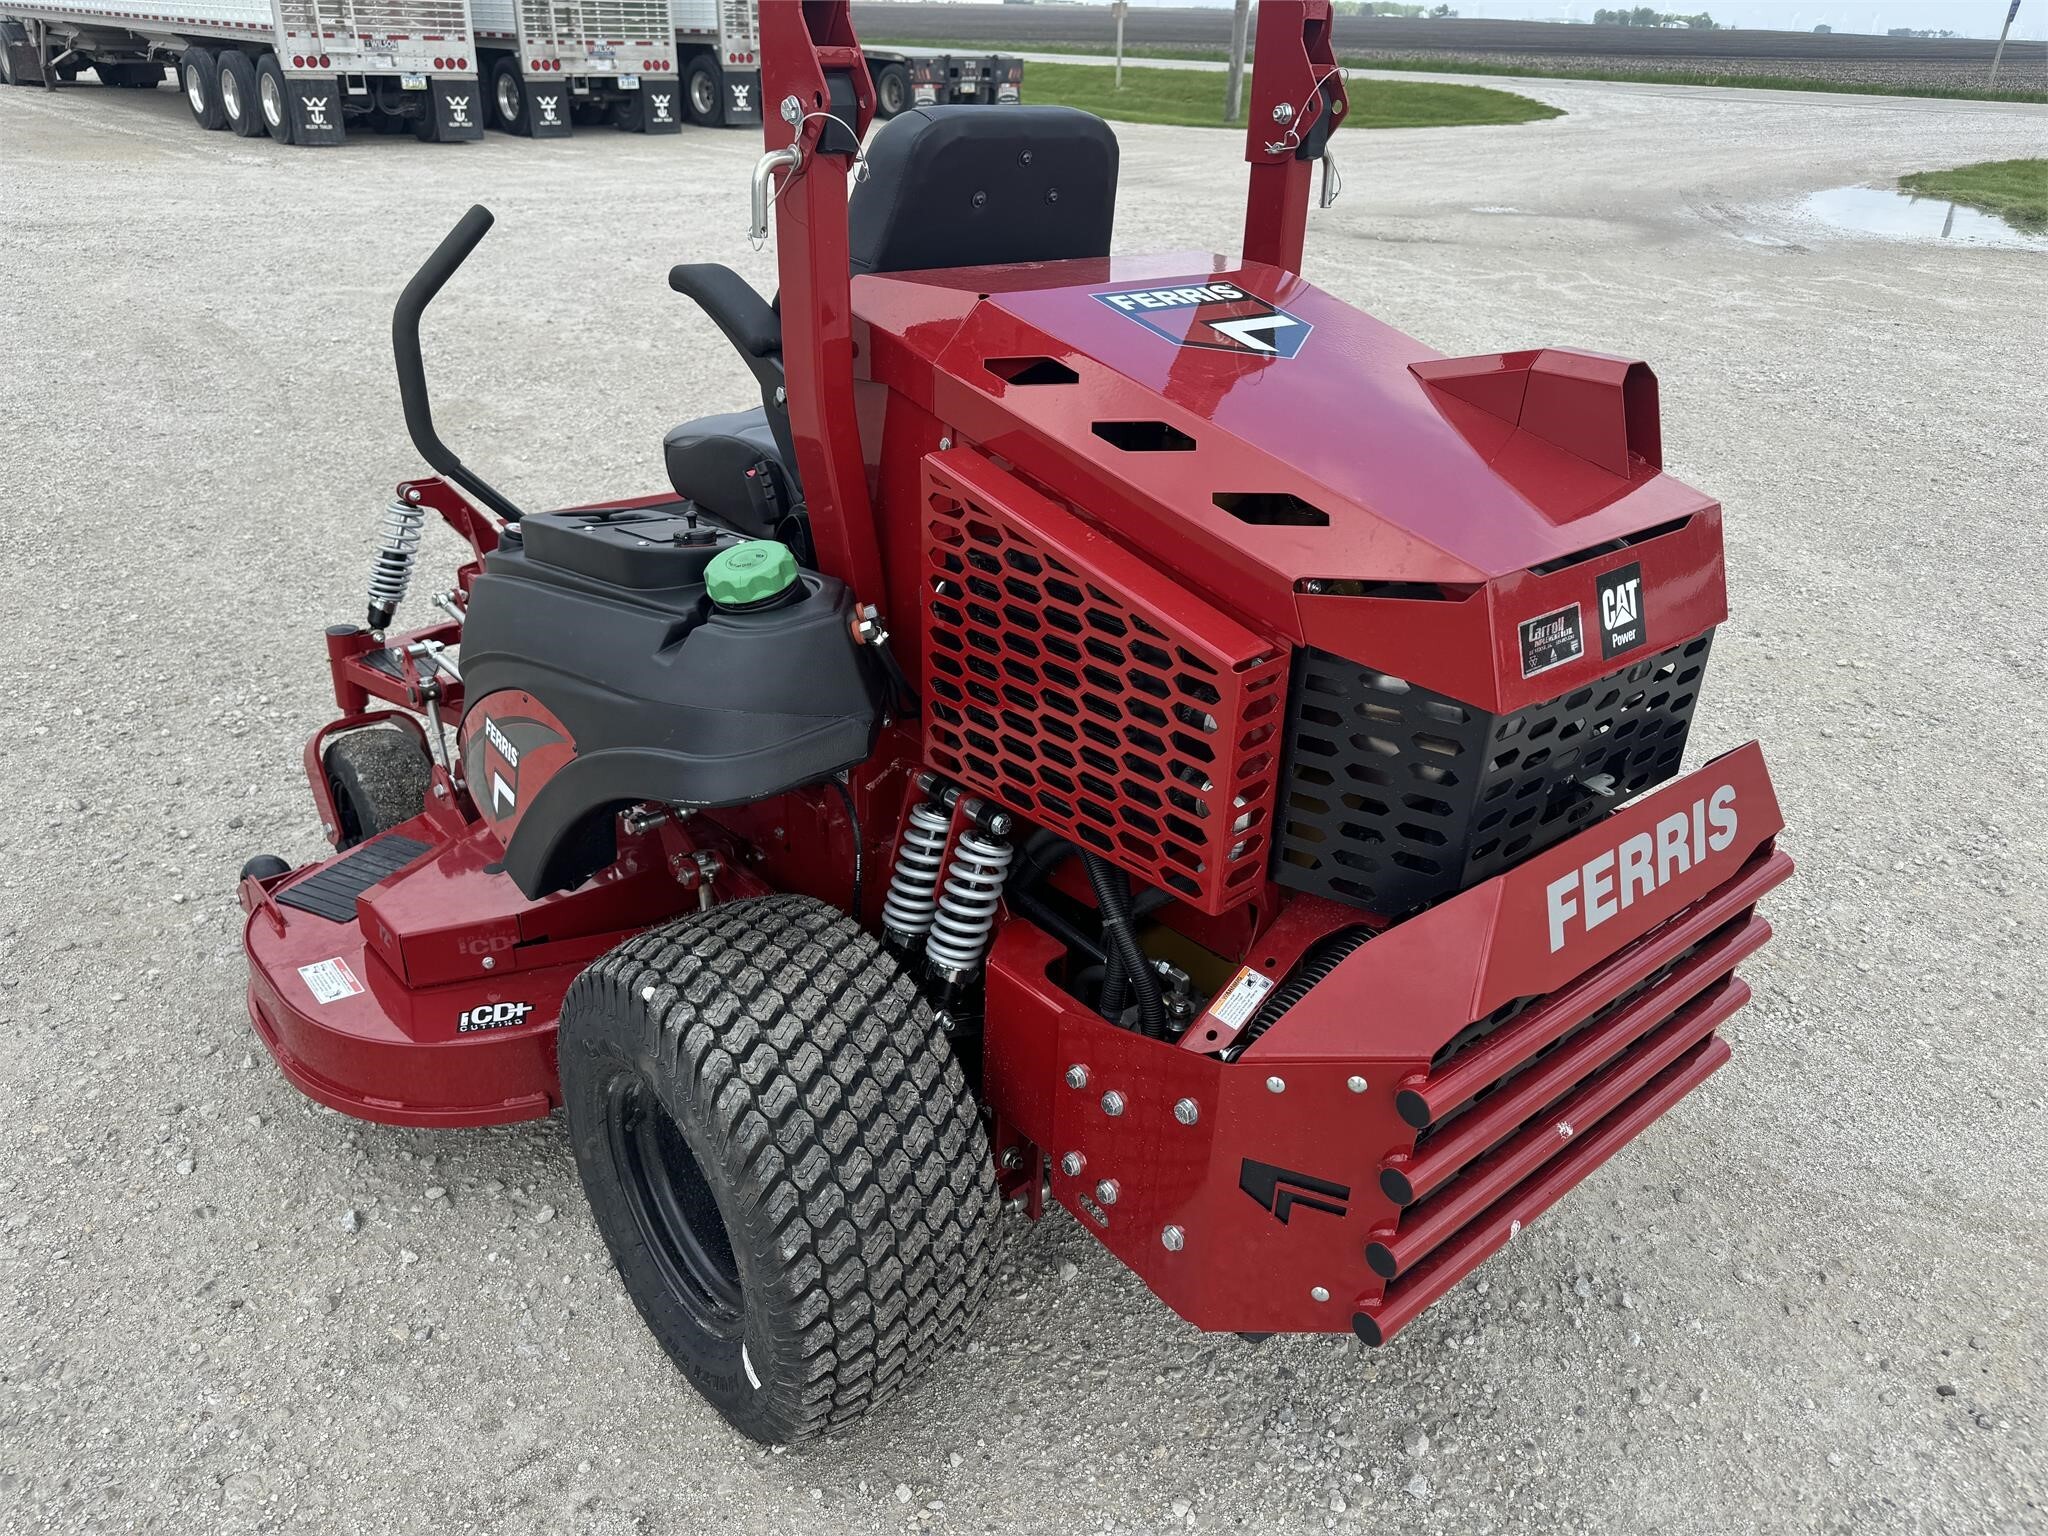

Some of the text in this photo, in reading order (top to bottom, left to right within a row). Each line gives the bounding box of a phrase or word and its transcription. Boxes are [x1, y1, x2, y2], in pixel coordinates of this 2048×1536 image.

[1106, 284, 1244, 311] FERRIS
[1602, 578, 1638, 631] CAT
[1528, 616, 1565, 643] Carroll
[1612, 628, 1637, 648] Power
[485, 716, 518, 768] FERRIS
[1546, 784, 1738, 954] FERRIS
[459, 1018, 523, 1032] CUTTING
